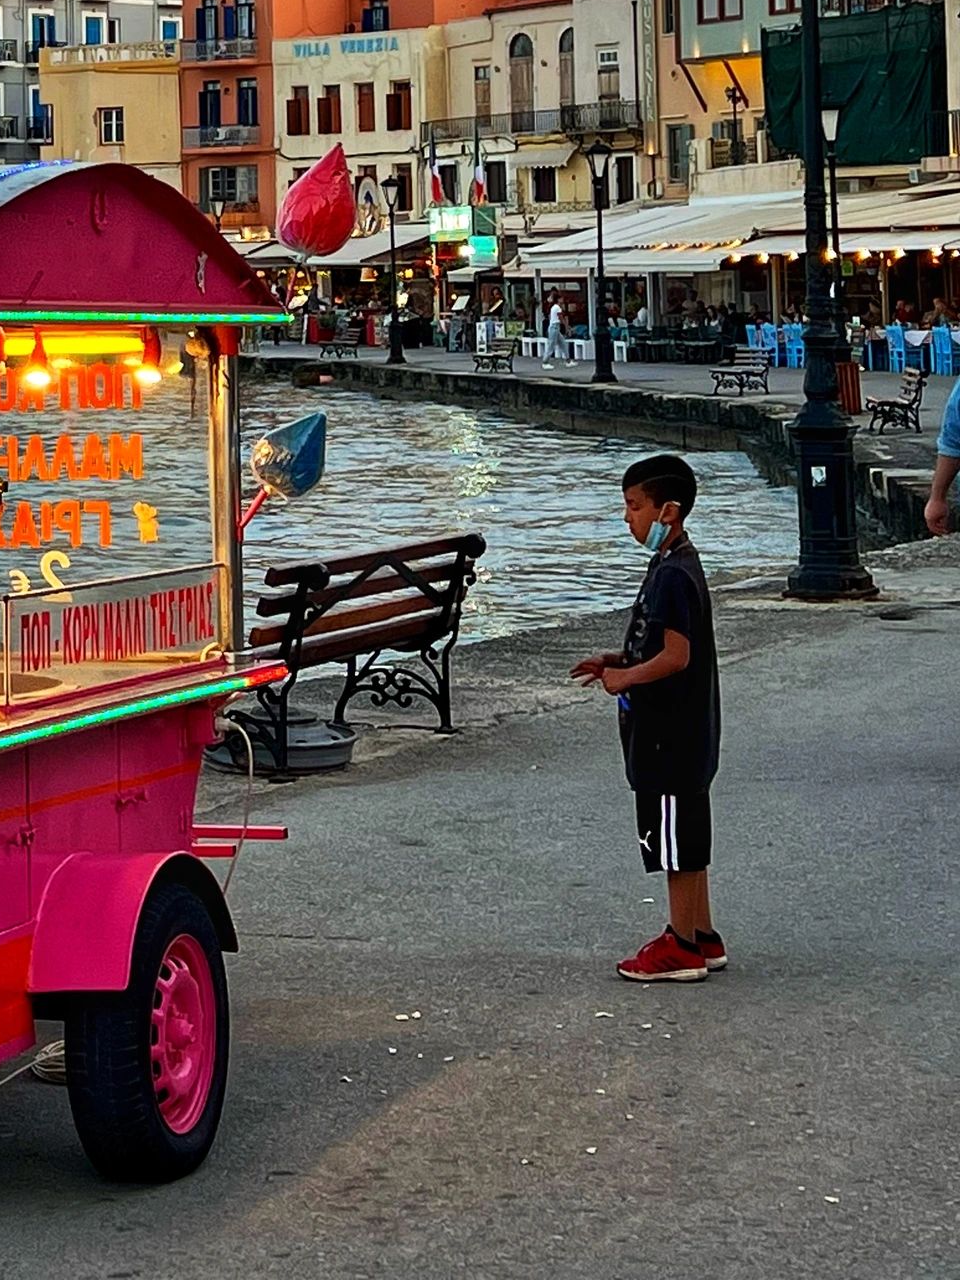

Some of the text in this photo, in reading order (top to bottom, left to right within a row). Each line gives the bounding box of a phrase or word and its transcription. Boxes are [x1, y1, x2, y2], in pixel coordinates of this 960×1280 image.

[293, 37, 399, 57] VILLA VENEZIA
[21, 611, 51, 672] ΠΟΠ
[62, 603, 100, 665] ΚΟΡΝ
[103, 596, 147, 662] ΜΑΛΛΙ
[149, 590, 176, 651] ΤΗΣ
